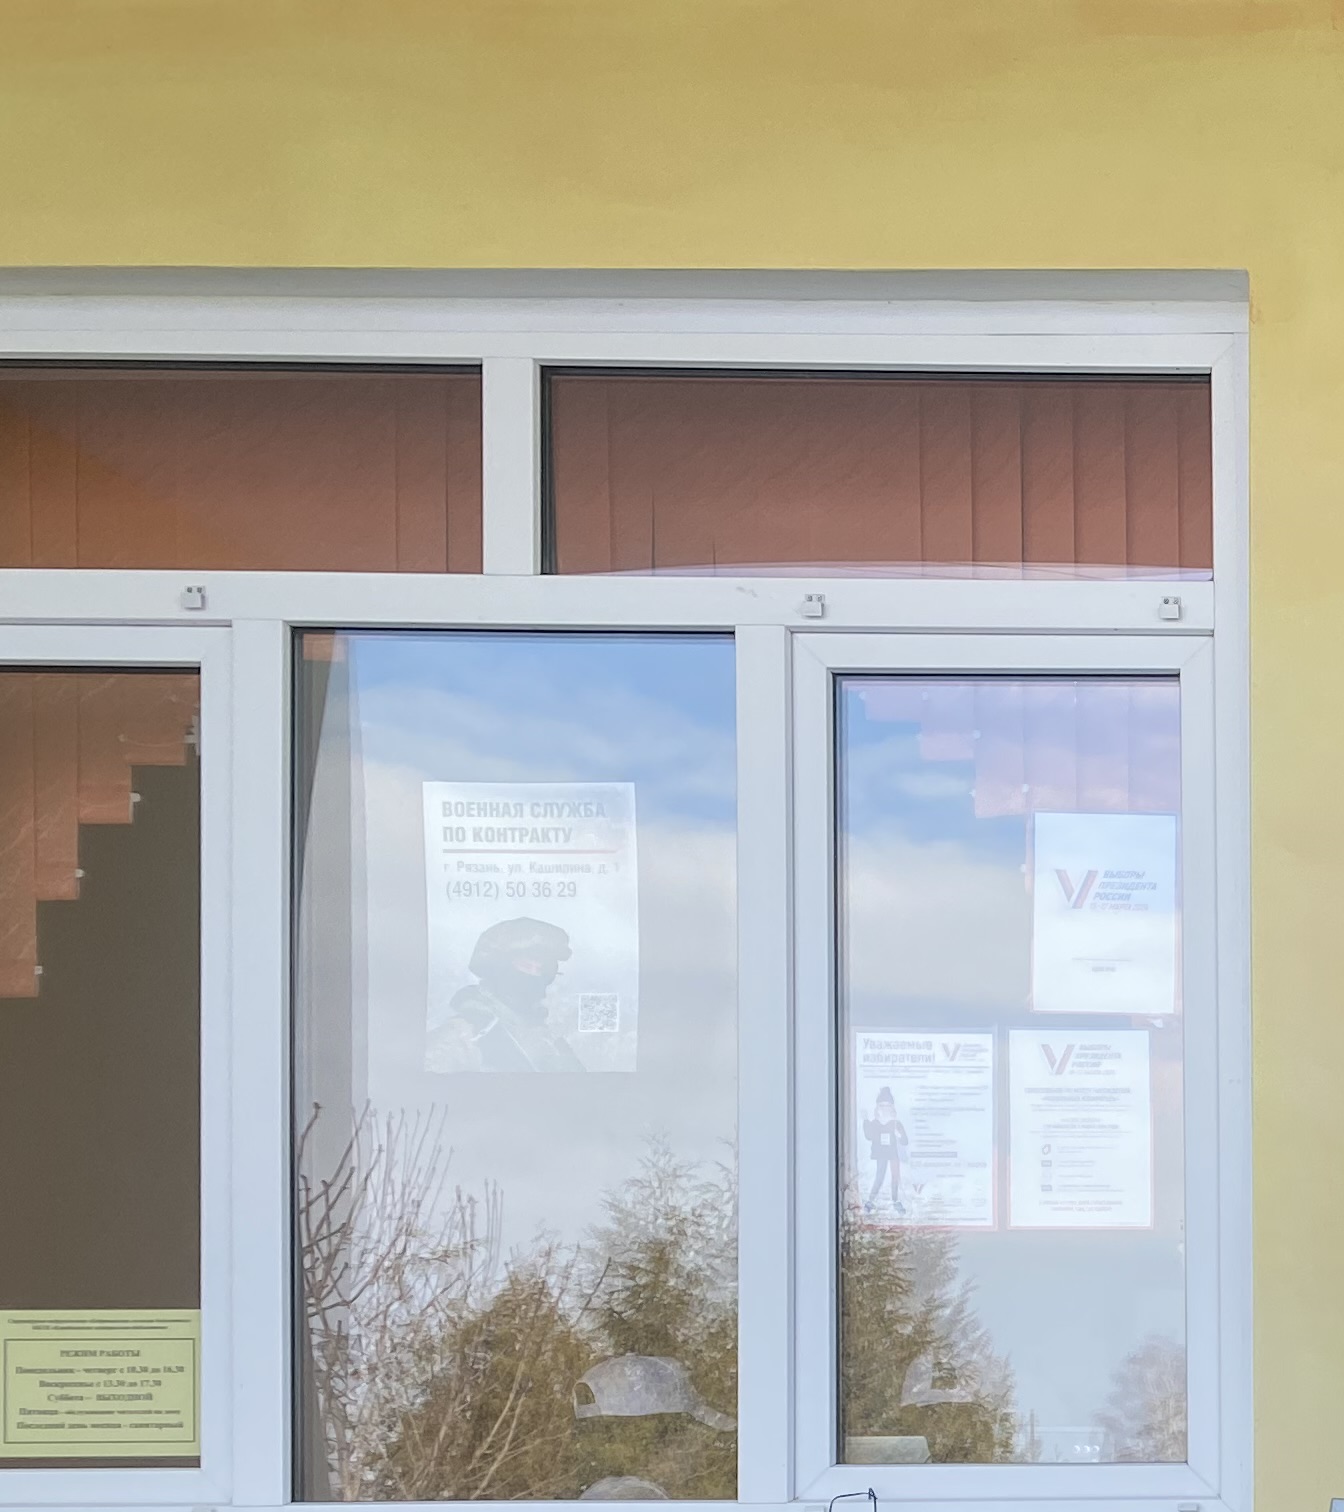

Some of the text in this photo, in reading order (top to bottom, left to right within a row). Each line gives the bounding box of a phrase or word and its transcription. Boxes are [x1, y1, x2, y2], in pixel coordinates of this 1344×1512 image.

[441, 800, 608, 819] ВОЕННАЯ СЛУЖБА
[442, 826, 573, 843] ПО КОНТРАКТУ
[1103, 870, 1146, 879] ВЫБОРЫ
[446, 880, 577, 901] (4912) 50 36 29
[1092, 891, 1132, 901] РОССИИ
